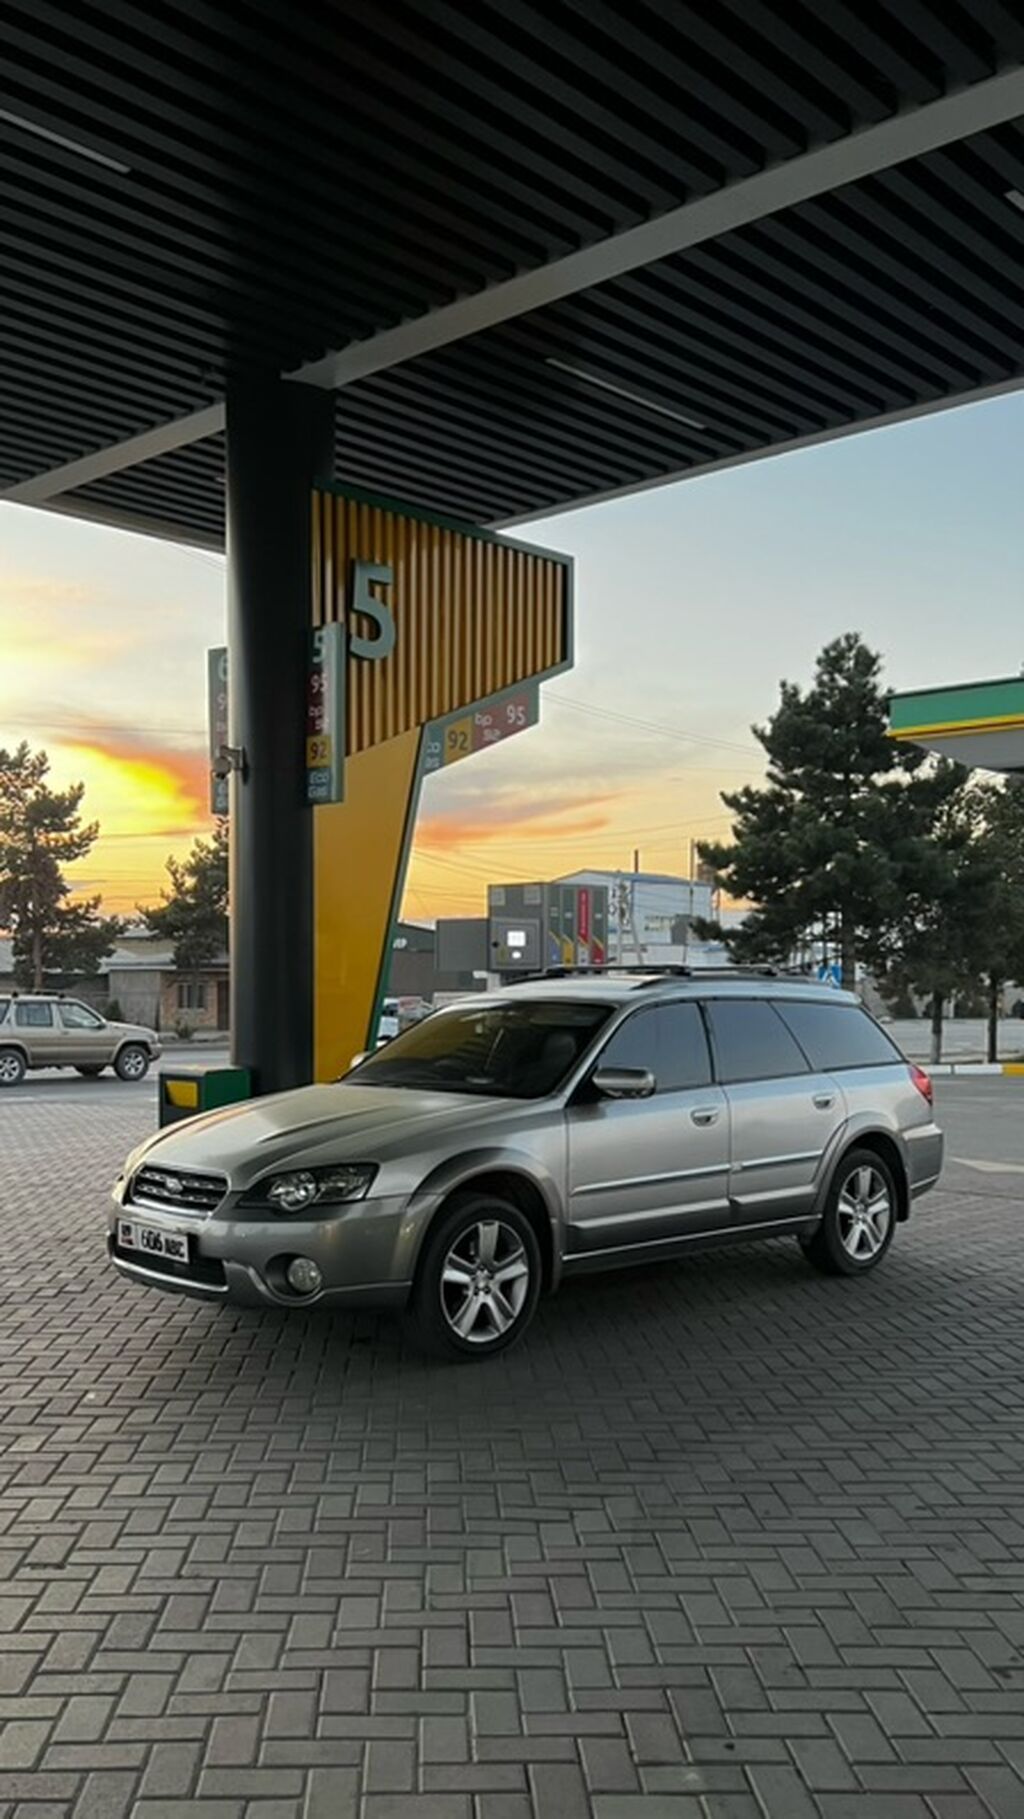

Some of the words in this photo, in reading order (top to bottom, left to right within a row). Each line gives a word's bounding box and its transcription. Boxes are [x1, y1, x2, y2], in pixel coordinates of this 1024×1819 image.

[350, 563, 396, 660] 5
[312, 629, 328, 664] 5
[506, 704, 526, 725] 95
[310, 741, 328, 760] 92
[447, 730, 469, 751] 92
[141, 1230, 163, 1253] 606
